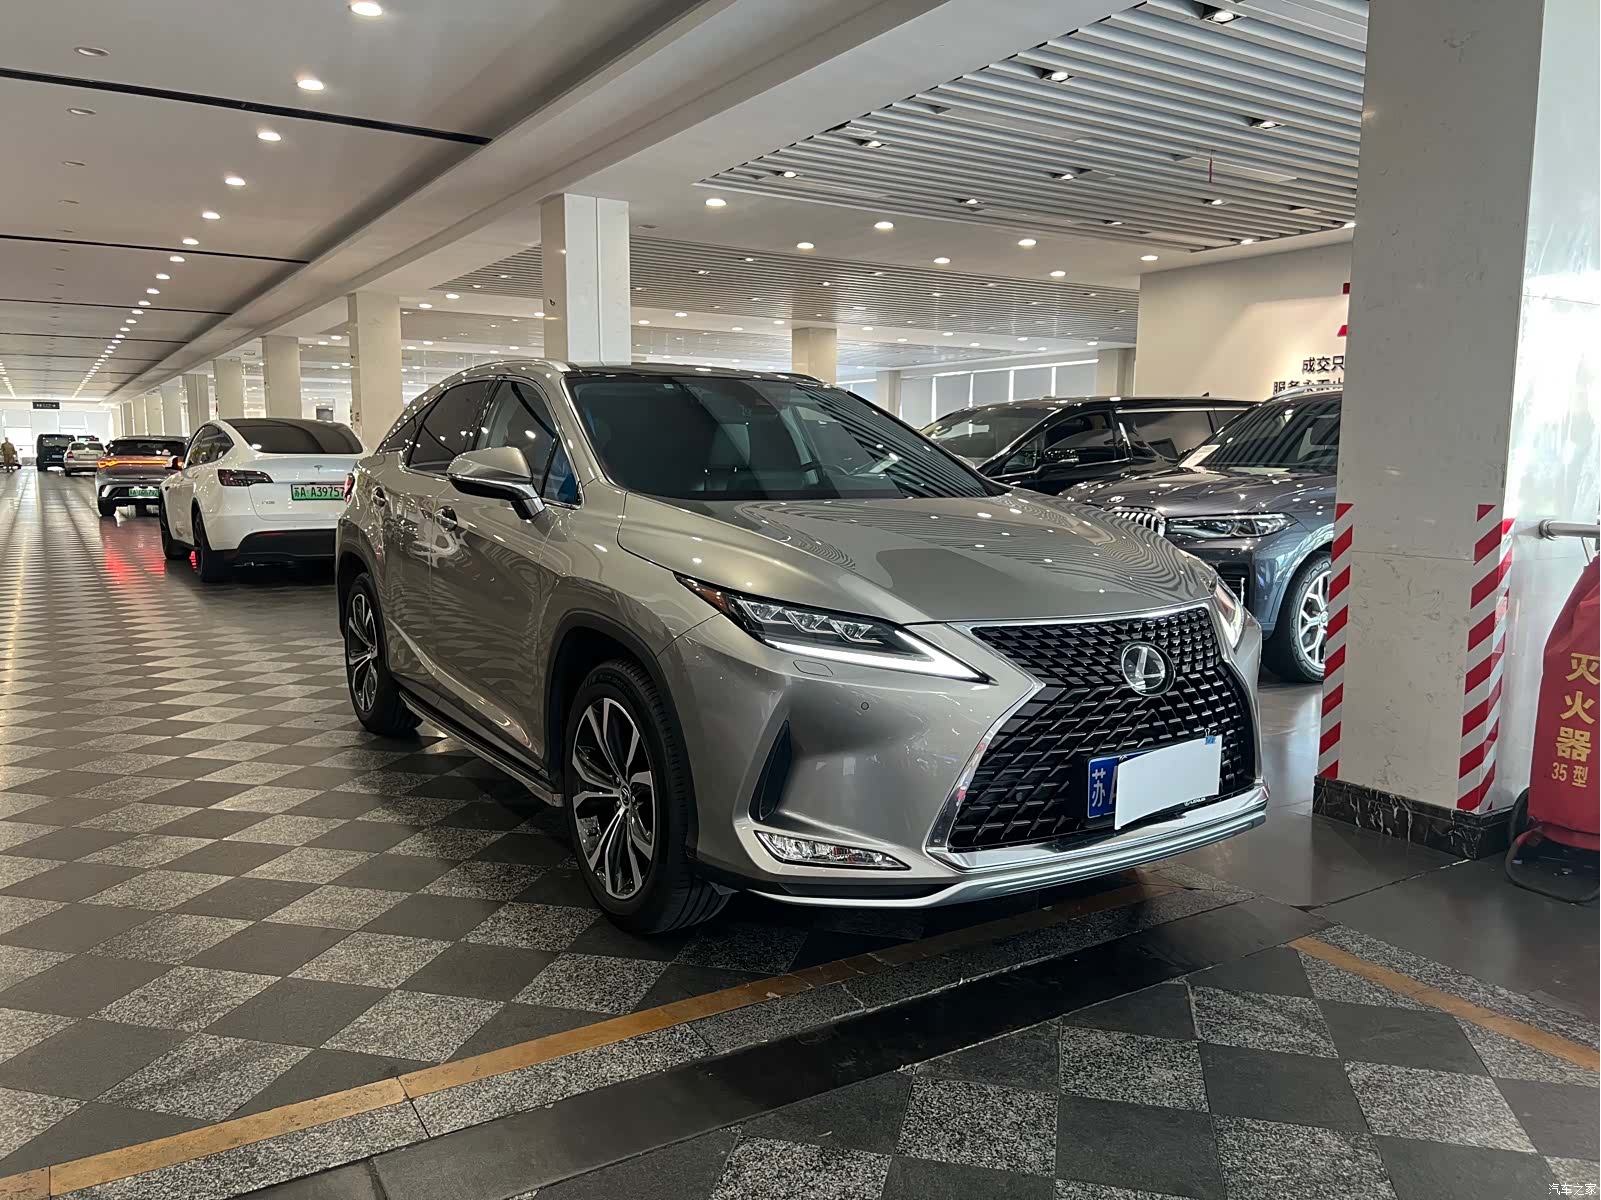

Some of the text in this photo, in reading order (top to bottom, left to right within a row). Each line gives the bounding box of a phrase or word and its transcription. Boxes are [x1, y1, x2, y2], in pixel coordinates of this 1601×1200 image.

[1302, 355, 1344, 373] 成交只
[1556, 652, 1600, 762] 灭火器
[1551, 762, 1588, 788] 35 型
